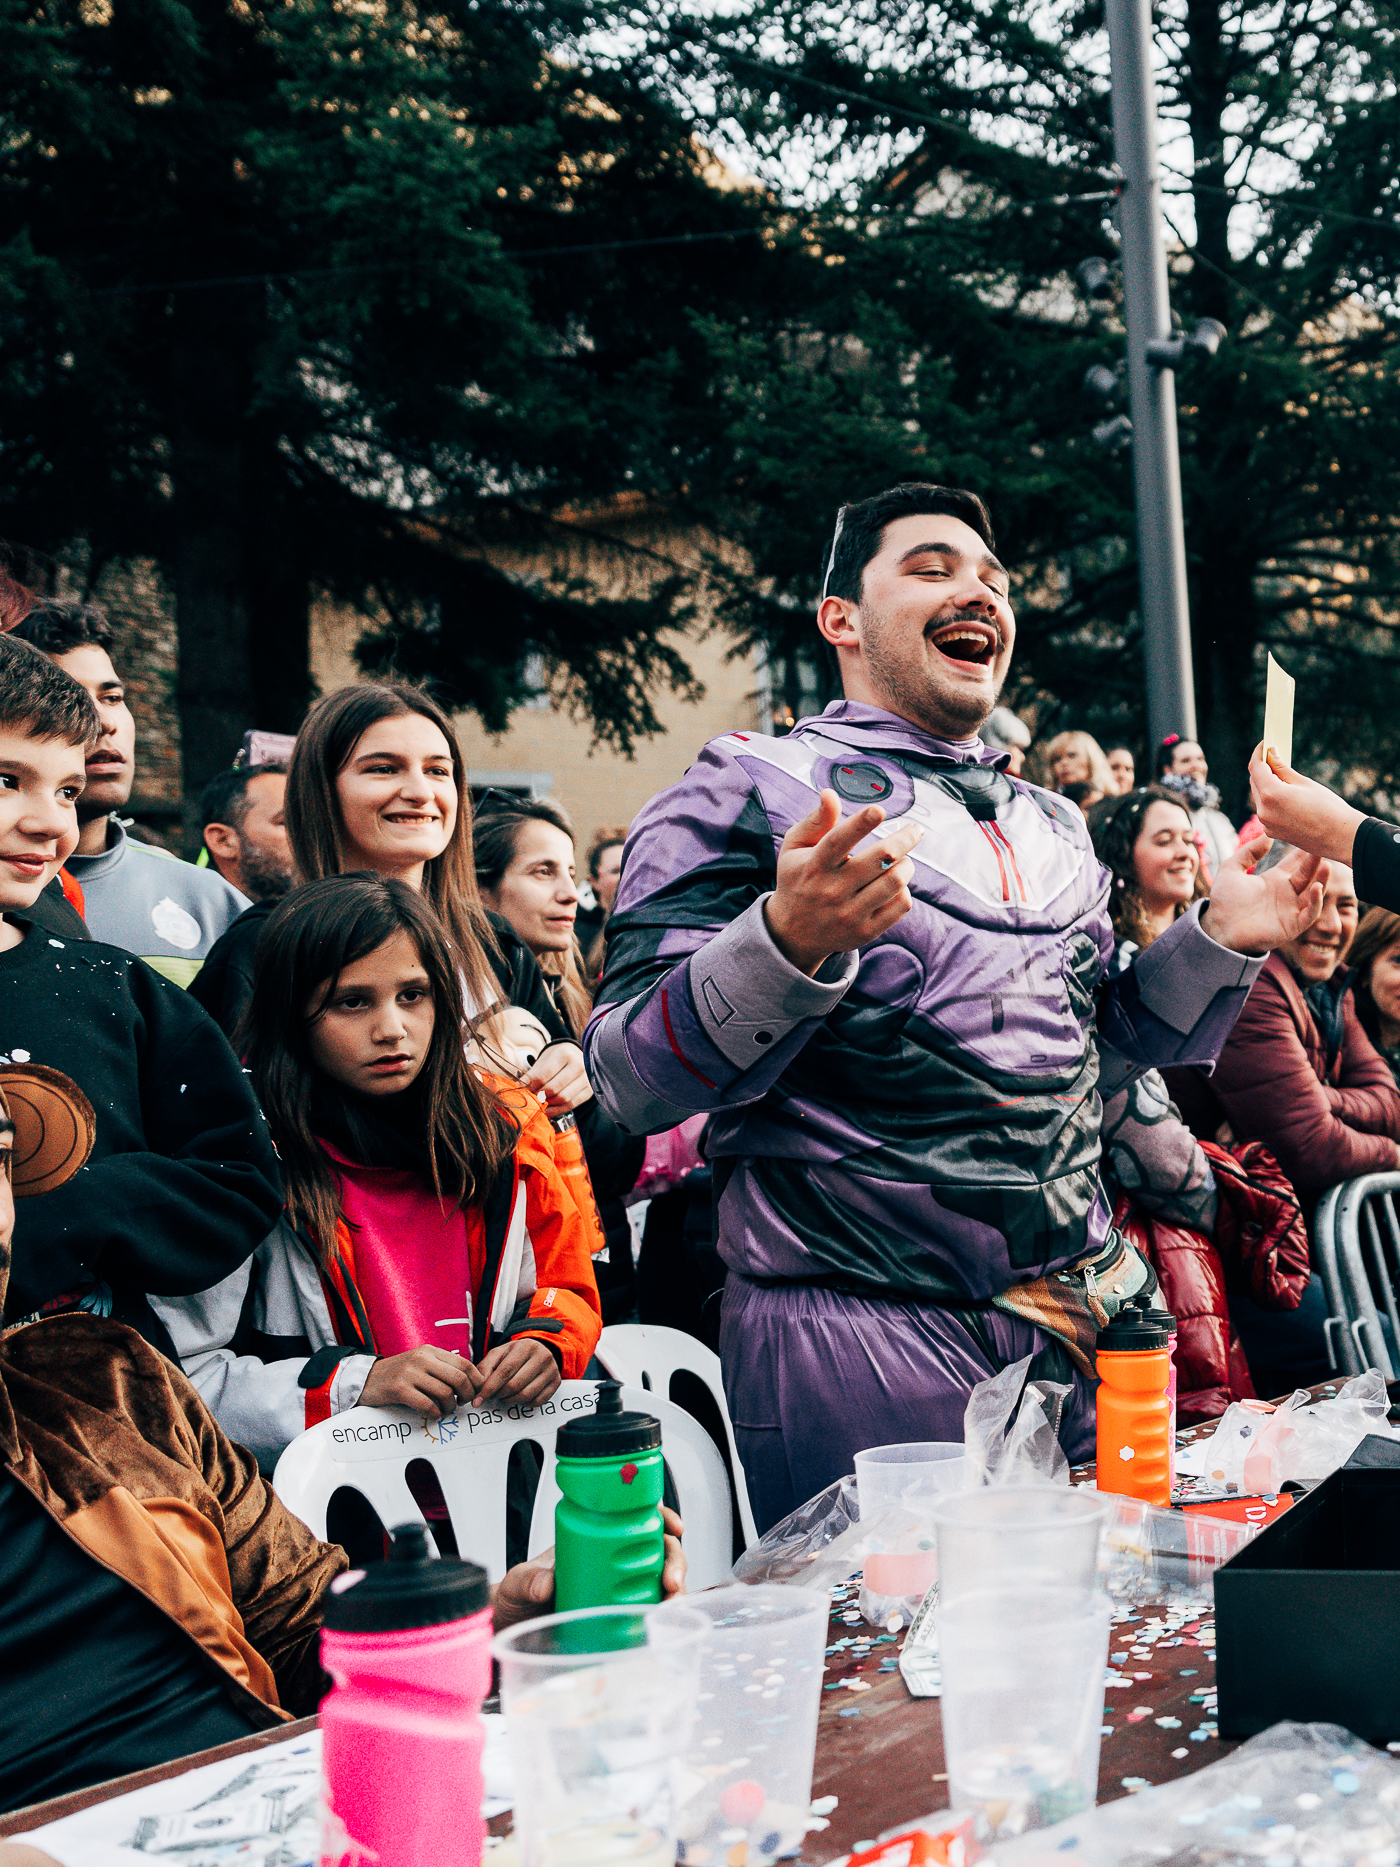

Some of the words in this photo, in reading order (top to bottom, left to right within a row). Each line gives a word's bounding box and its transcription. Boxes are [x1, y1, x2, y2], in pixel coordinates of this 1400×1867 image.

[332, 1420, 412, 1444] encamp
[467, 1408, 503, 1433] pas
[507, 1403, 534, 1420] de
